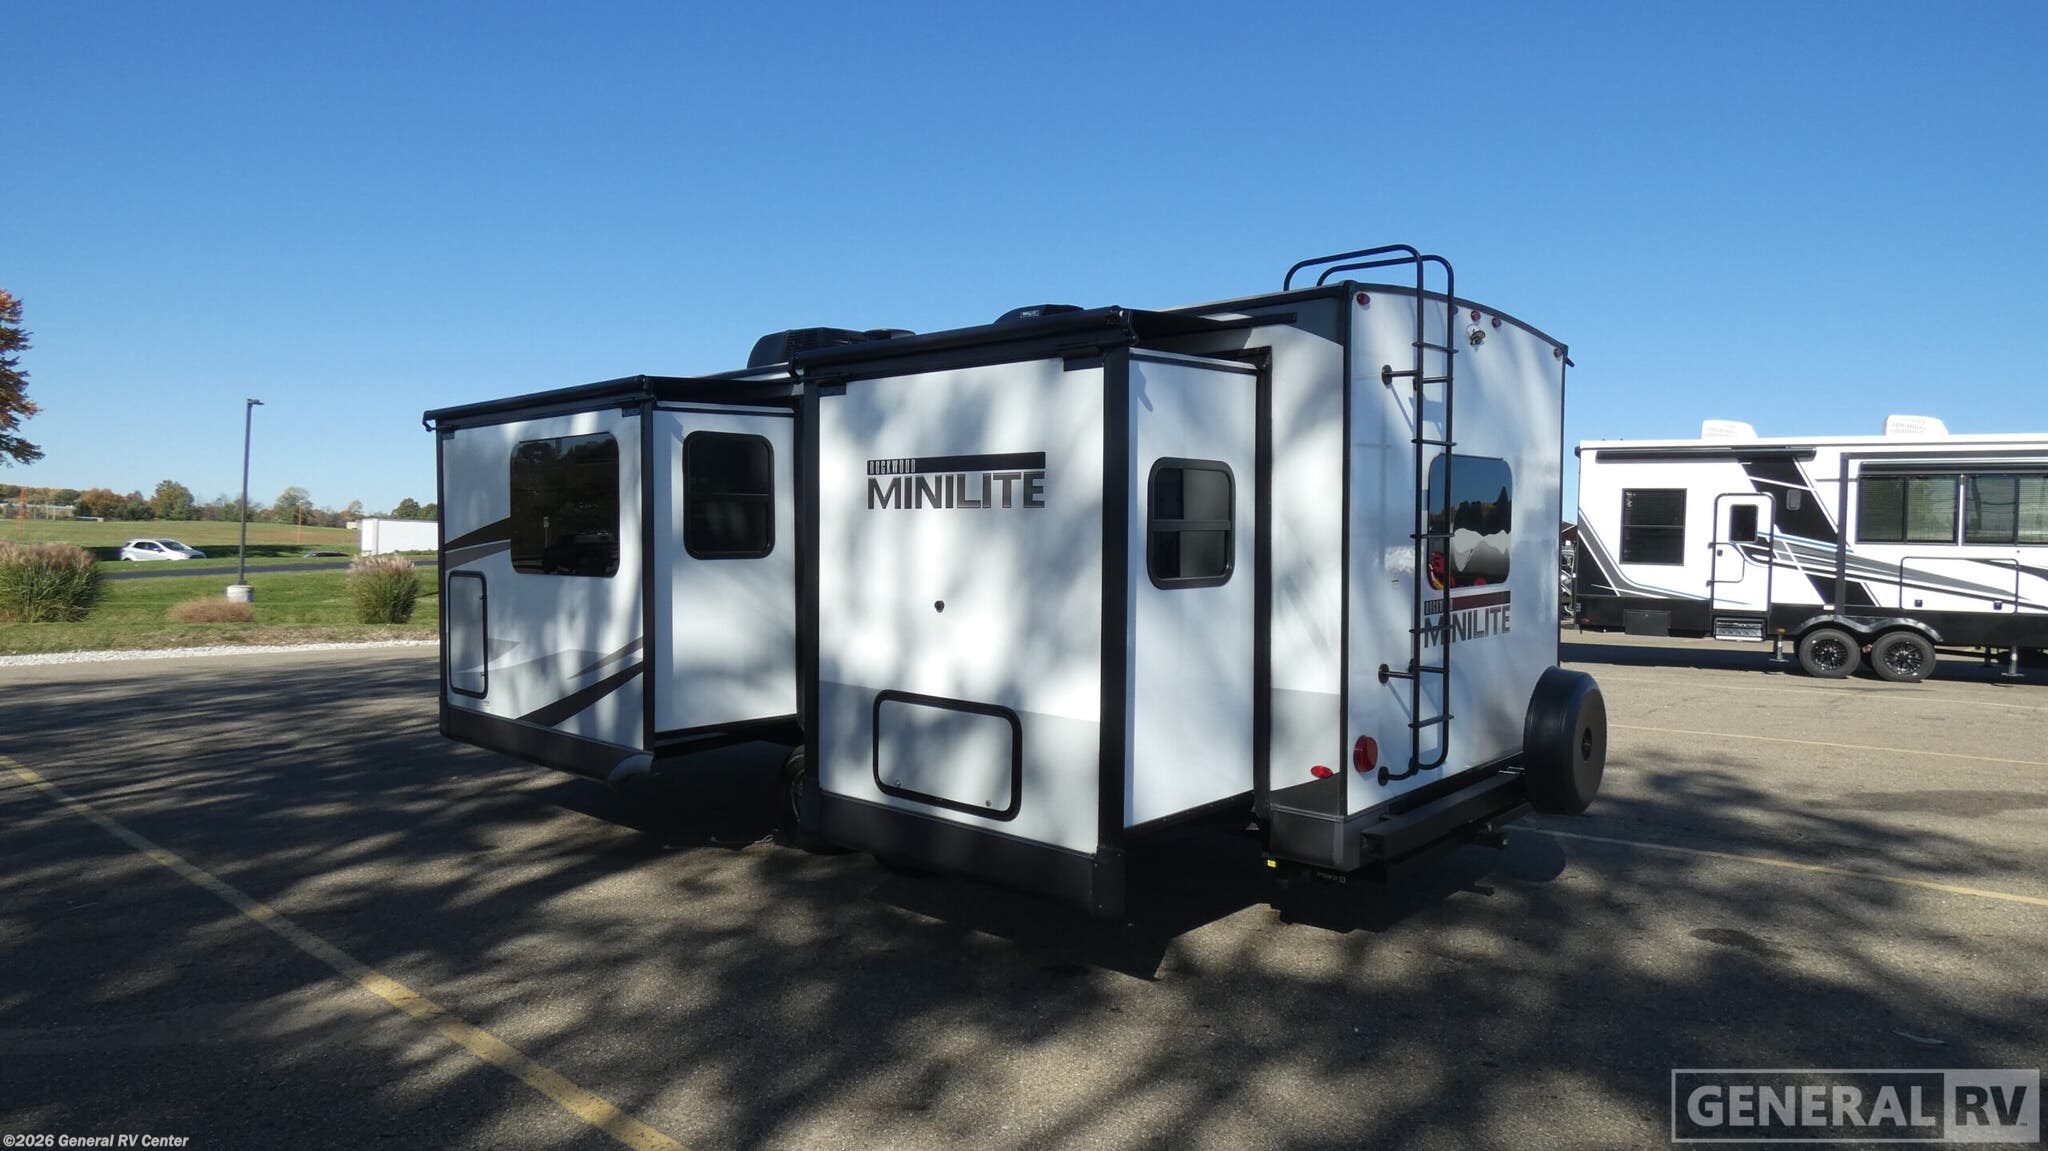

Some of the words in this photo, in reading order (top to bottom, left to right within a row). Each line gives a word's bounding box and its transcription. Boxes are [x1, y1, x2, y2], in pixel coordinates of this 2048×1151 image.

[869, 459, 916, 474] ROCKWOOD
[867, 471, 1045, 509] MINILITE
[1424, 604, 1511, 648] MNILITE
